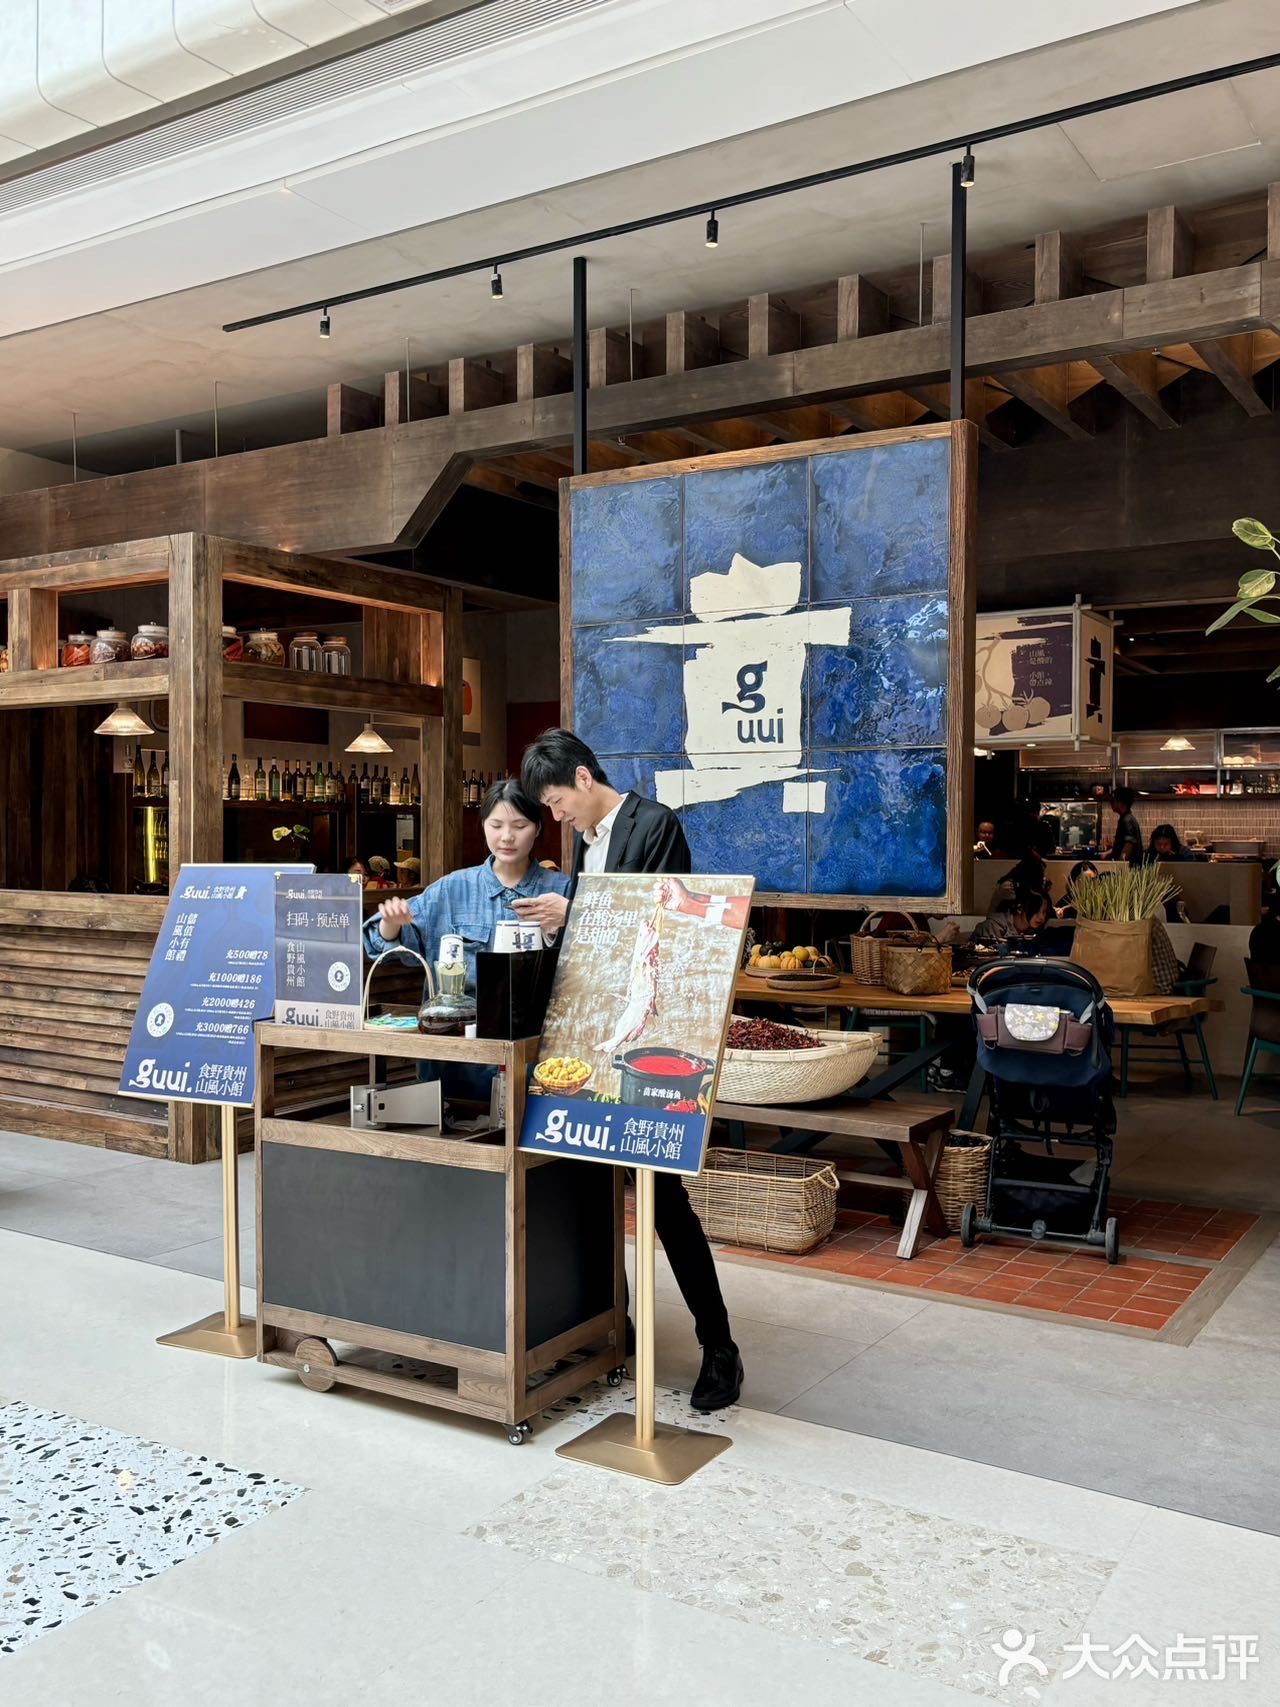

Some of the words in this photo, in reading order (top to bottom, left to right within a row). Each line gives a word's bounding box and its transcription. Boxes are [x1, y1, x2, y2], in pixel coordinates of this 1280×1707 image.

[737, 708, 784, 744] uui
[583, 891, 613, 909] 鲜鱼
[164, 912, 189, 961] 山風小館
[286, 942, 296, 987] 食野貴州
[296, 942, 306, 987] 山風小館
[128, 1058, 193, 1093] guui.
[194, 1078, 245, 1097] 山風小館
[198, 1062, 248, 1082] 食野貴州
[535, 1109, 616, 1152] guui.
[623, 1117, 685, 1142] 食野貴州
[620, 1135, 683, 1160] 山風小館
